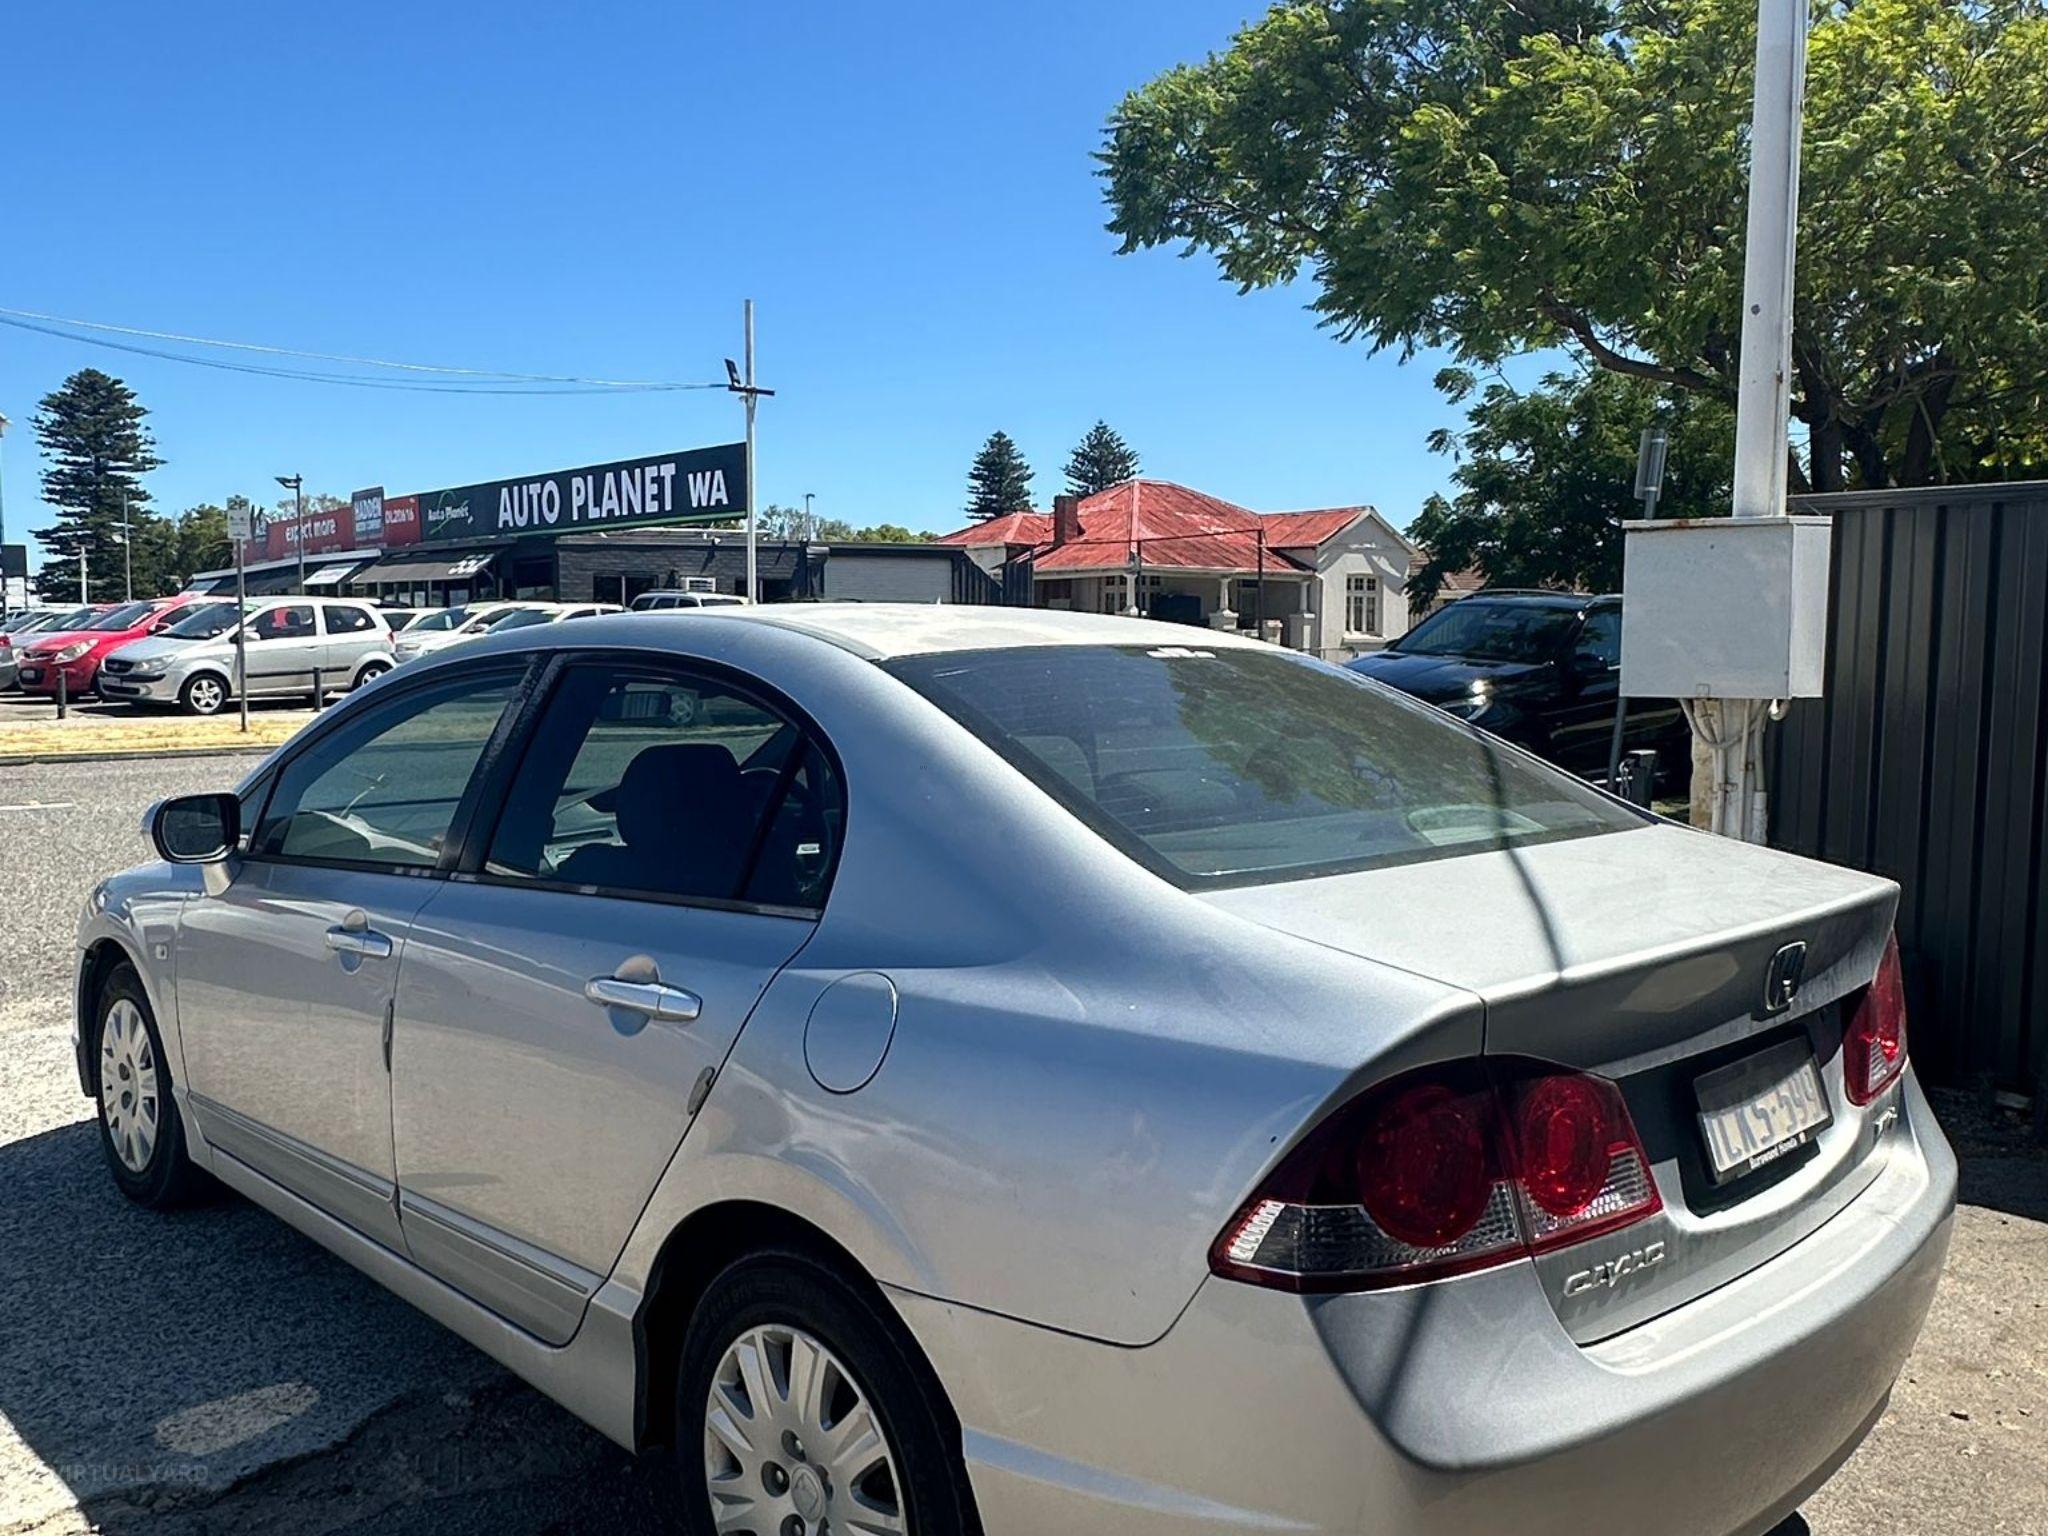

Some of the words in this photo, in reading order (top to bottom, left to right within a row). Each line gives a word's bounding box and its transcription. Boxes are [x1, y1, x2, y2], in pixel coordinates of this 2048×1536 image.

[498, 480, 560, 528] AUTO
[571, 463, 676, 521] PLANET
[688, 469, 729, 508] WA
[314, 518, 336, 536] more
[1564, 1241, 1664, 1297] CIVIC
